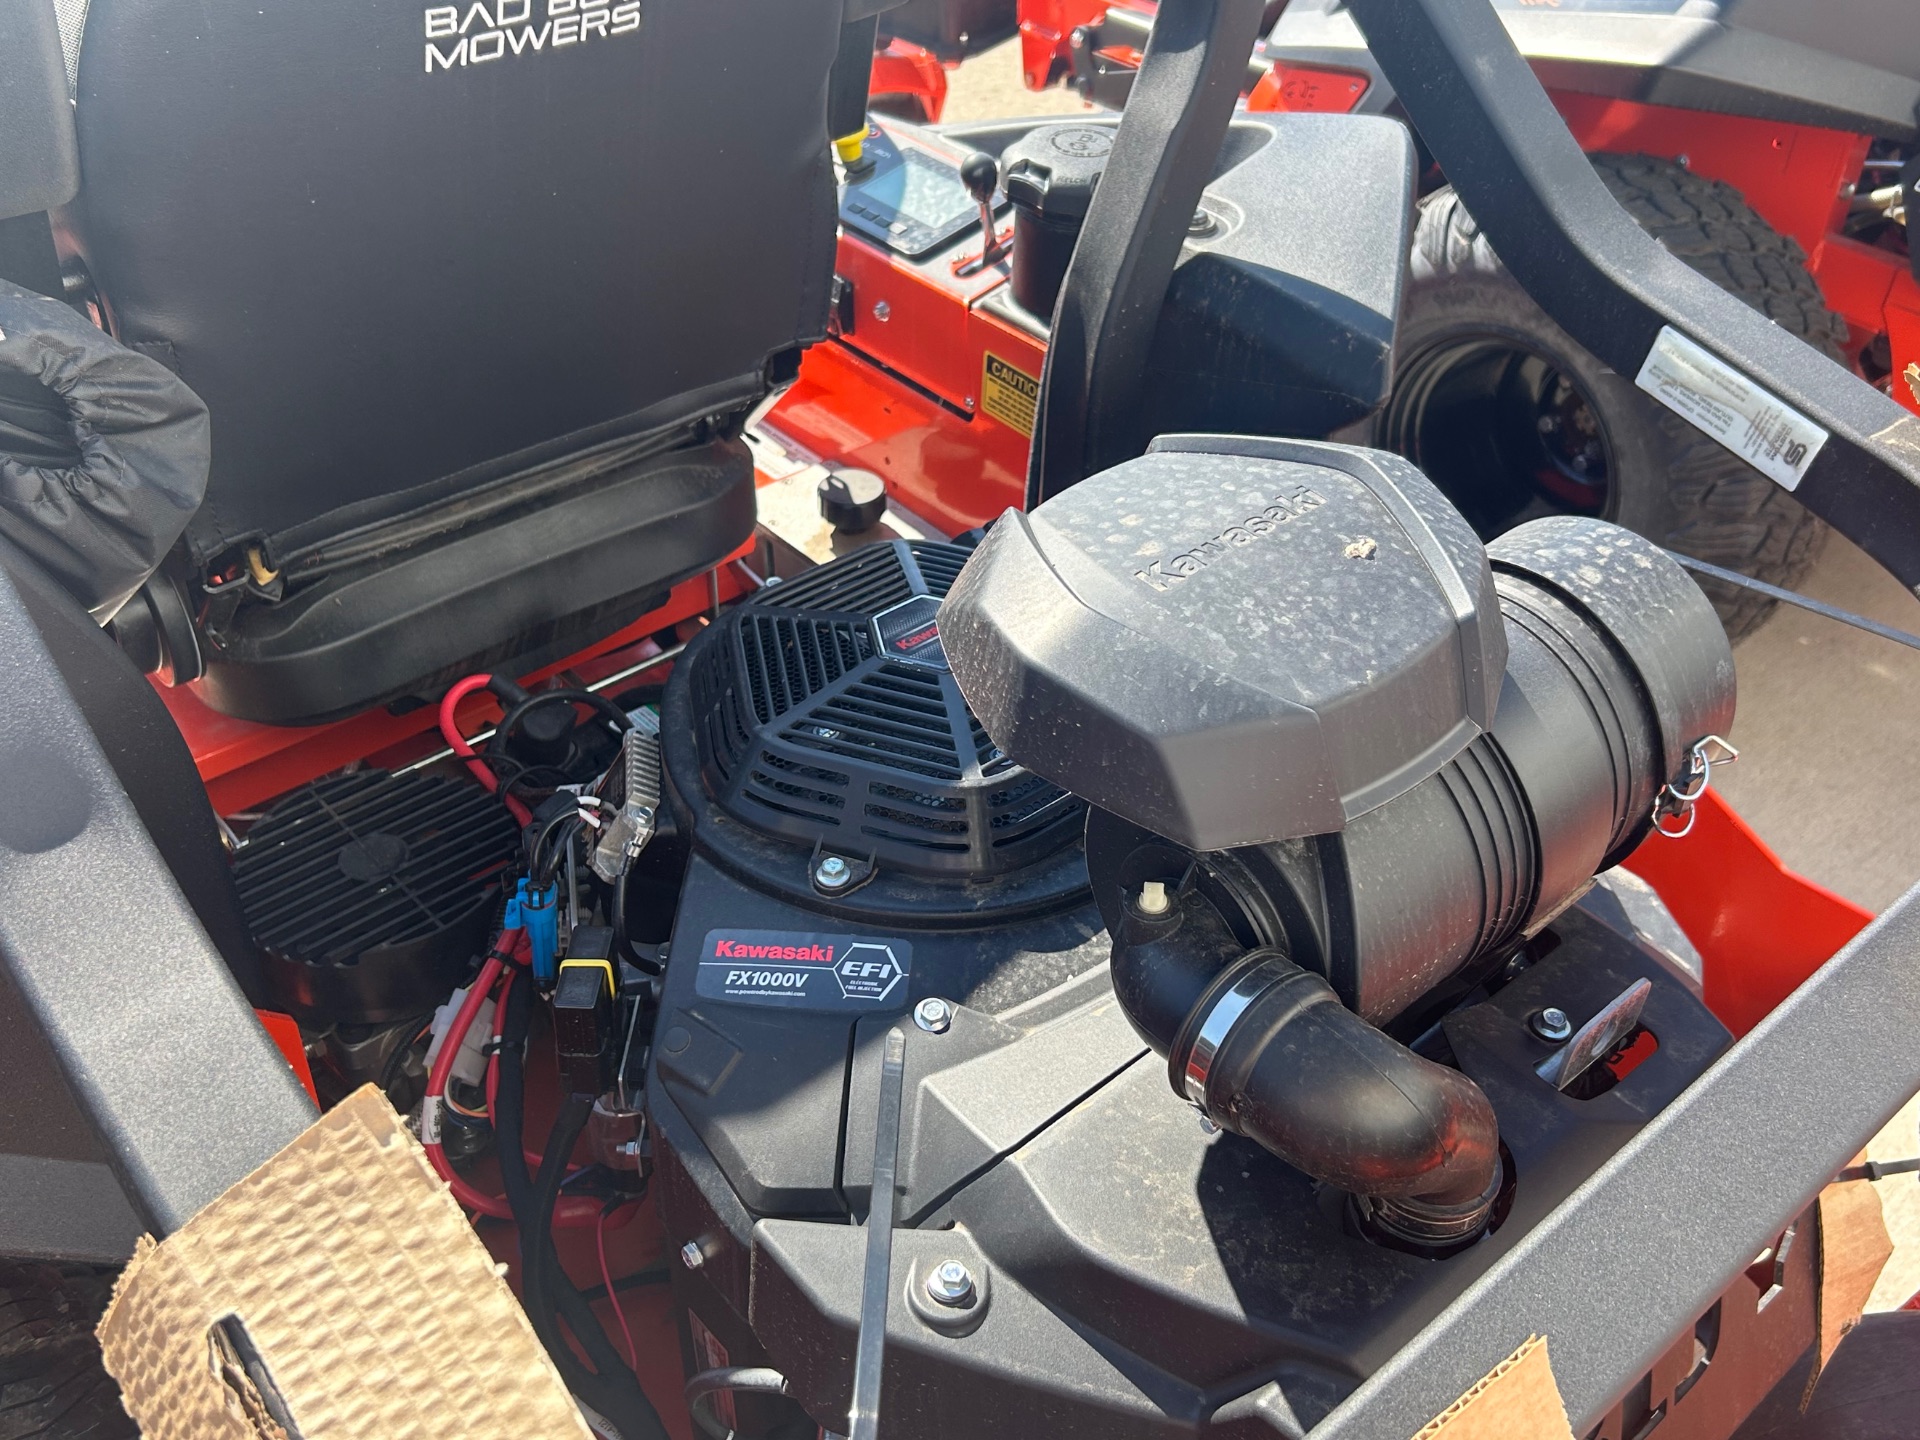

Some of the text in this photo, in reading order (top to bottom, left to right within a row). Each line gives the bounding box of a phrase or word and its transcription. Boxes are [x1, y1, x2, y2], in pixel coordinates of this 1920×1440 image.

[425, 0, 531, 38] BAD
[425, 1, 641, 73] MOWERS
[991, 361, 1037, 397] CAUTIO
[1134, 485, 1328, 592] Kawasaki
[896, 626, 939, 650] Kawa
[715, 940, 835, 962] Kawasaki
[725, 970, 809, 988] FX1000V
[841, 961, 892, 979] EFI
[725, 988, 806, 997] www.poweredbykawasaki.com
